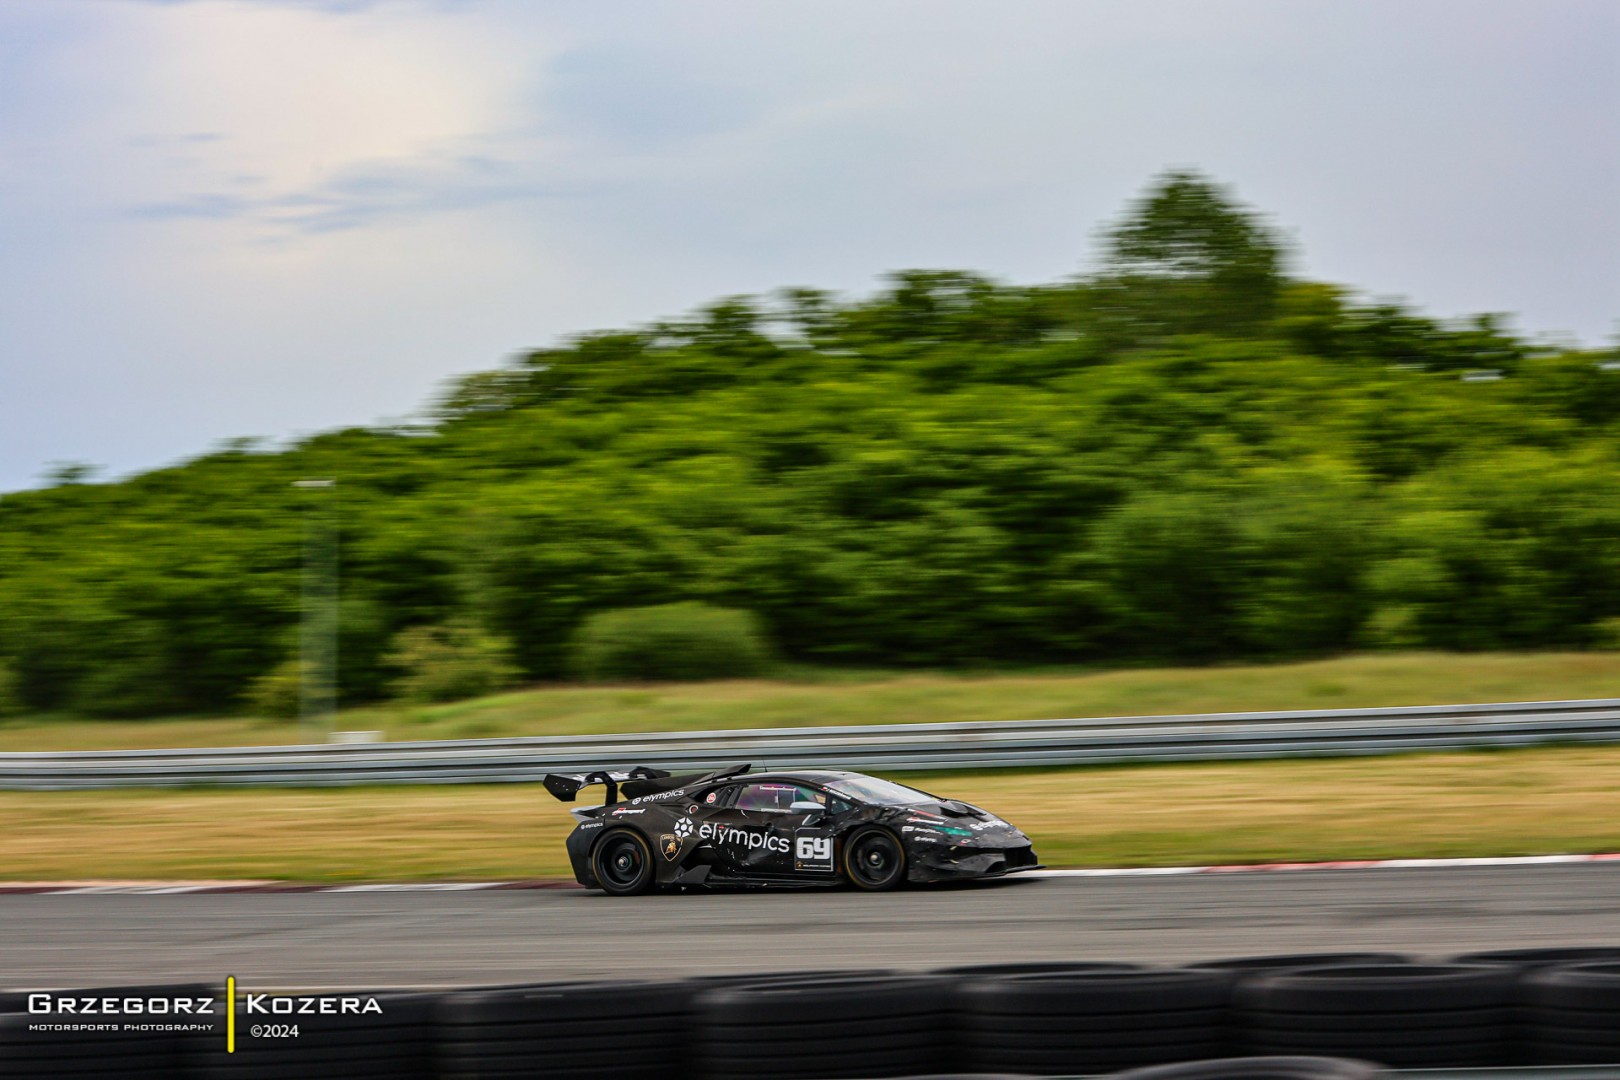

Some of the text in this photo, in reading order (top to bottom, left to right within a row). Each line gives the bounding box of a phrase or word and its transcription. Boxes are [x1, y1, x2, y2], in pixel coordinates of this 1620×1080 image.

[643, 789, 684, 803] elympics
[699, 823, 790, 853] elympics
[797, 837, 830, 859] 69
